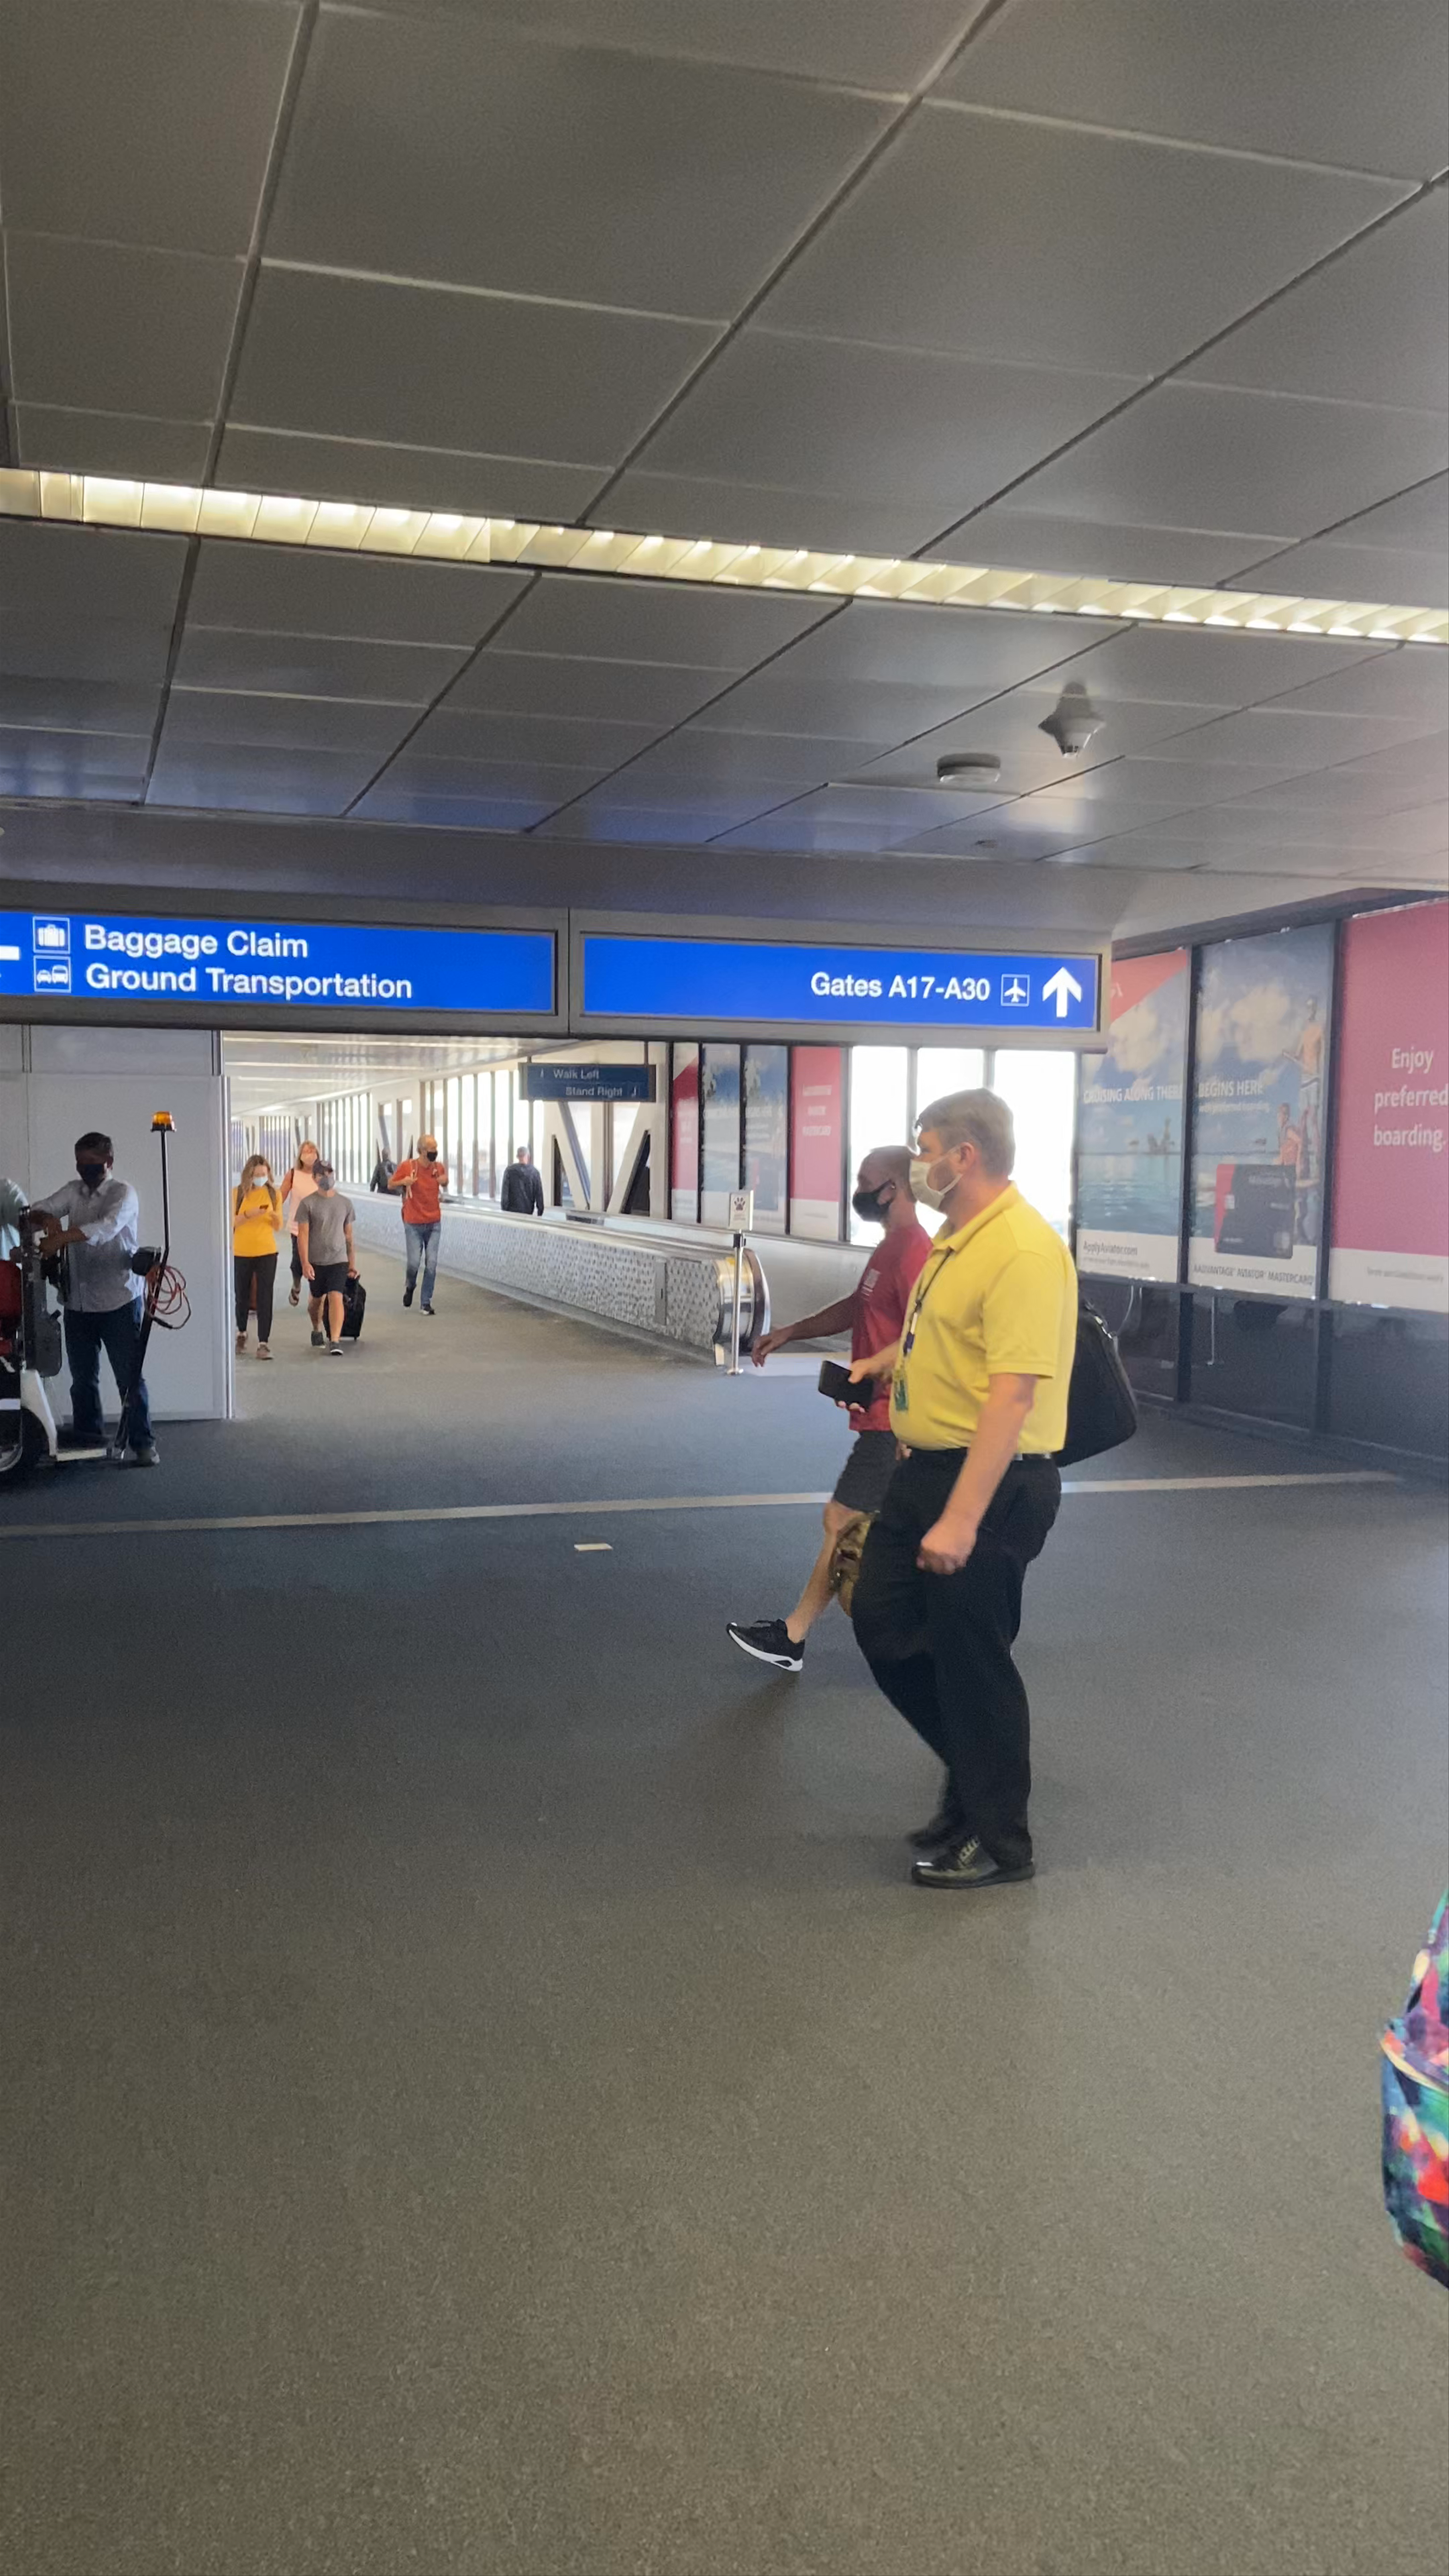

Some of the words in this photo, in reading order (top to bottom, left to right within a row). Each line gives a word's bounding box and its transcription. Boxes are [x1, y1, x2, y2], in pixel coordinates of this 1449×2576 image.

[85, 924, 218, 960] Baggage
[227, 930, 308, 958] Claim
[86, 963, 197, 992] Ground
[205, 967, 412, 1000] Transportation
[811, 971, 882, 998] Gates
[888, 975, 990, 1001] A17-A30
[553, 1069, 578, 1079] Walk
[581, 1069, 599, 1080] Left
[1392, 1046, 1434, 1074] Enjoy
[566, 1087, 595, 1096] Stand
[597, 1087, 623, 1098] Right
[1198, 1081, 1234, 1098] BEGINS
[1374, 1083, 1449, 1115] preferred
[1374, 1123, 1447, 1153] boarding.
